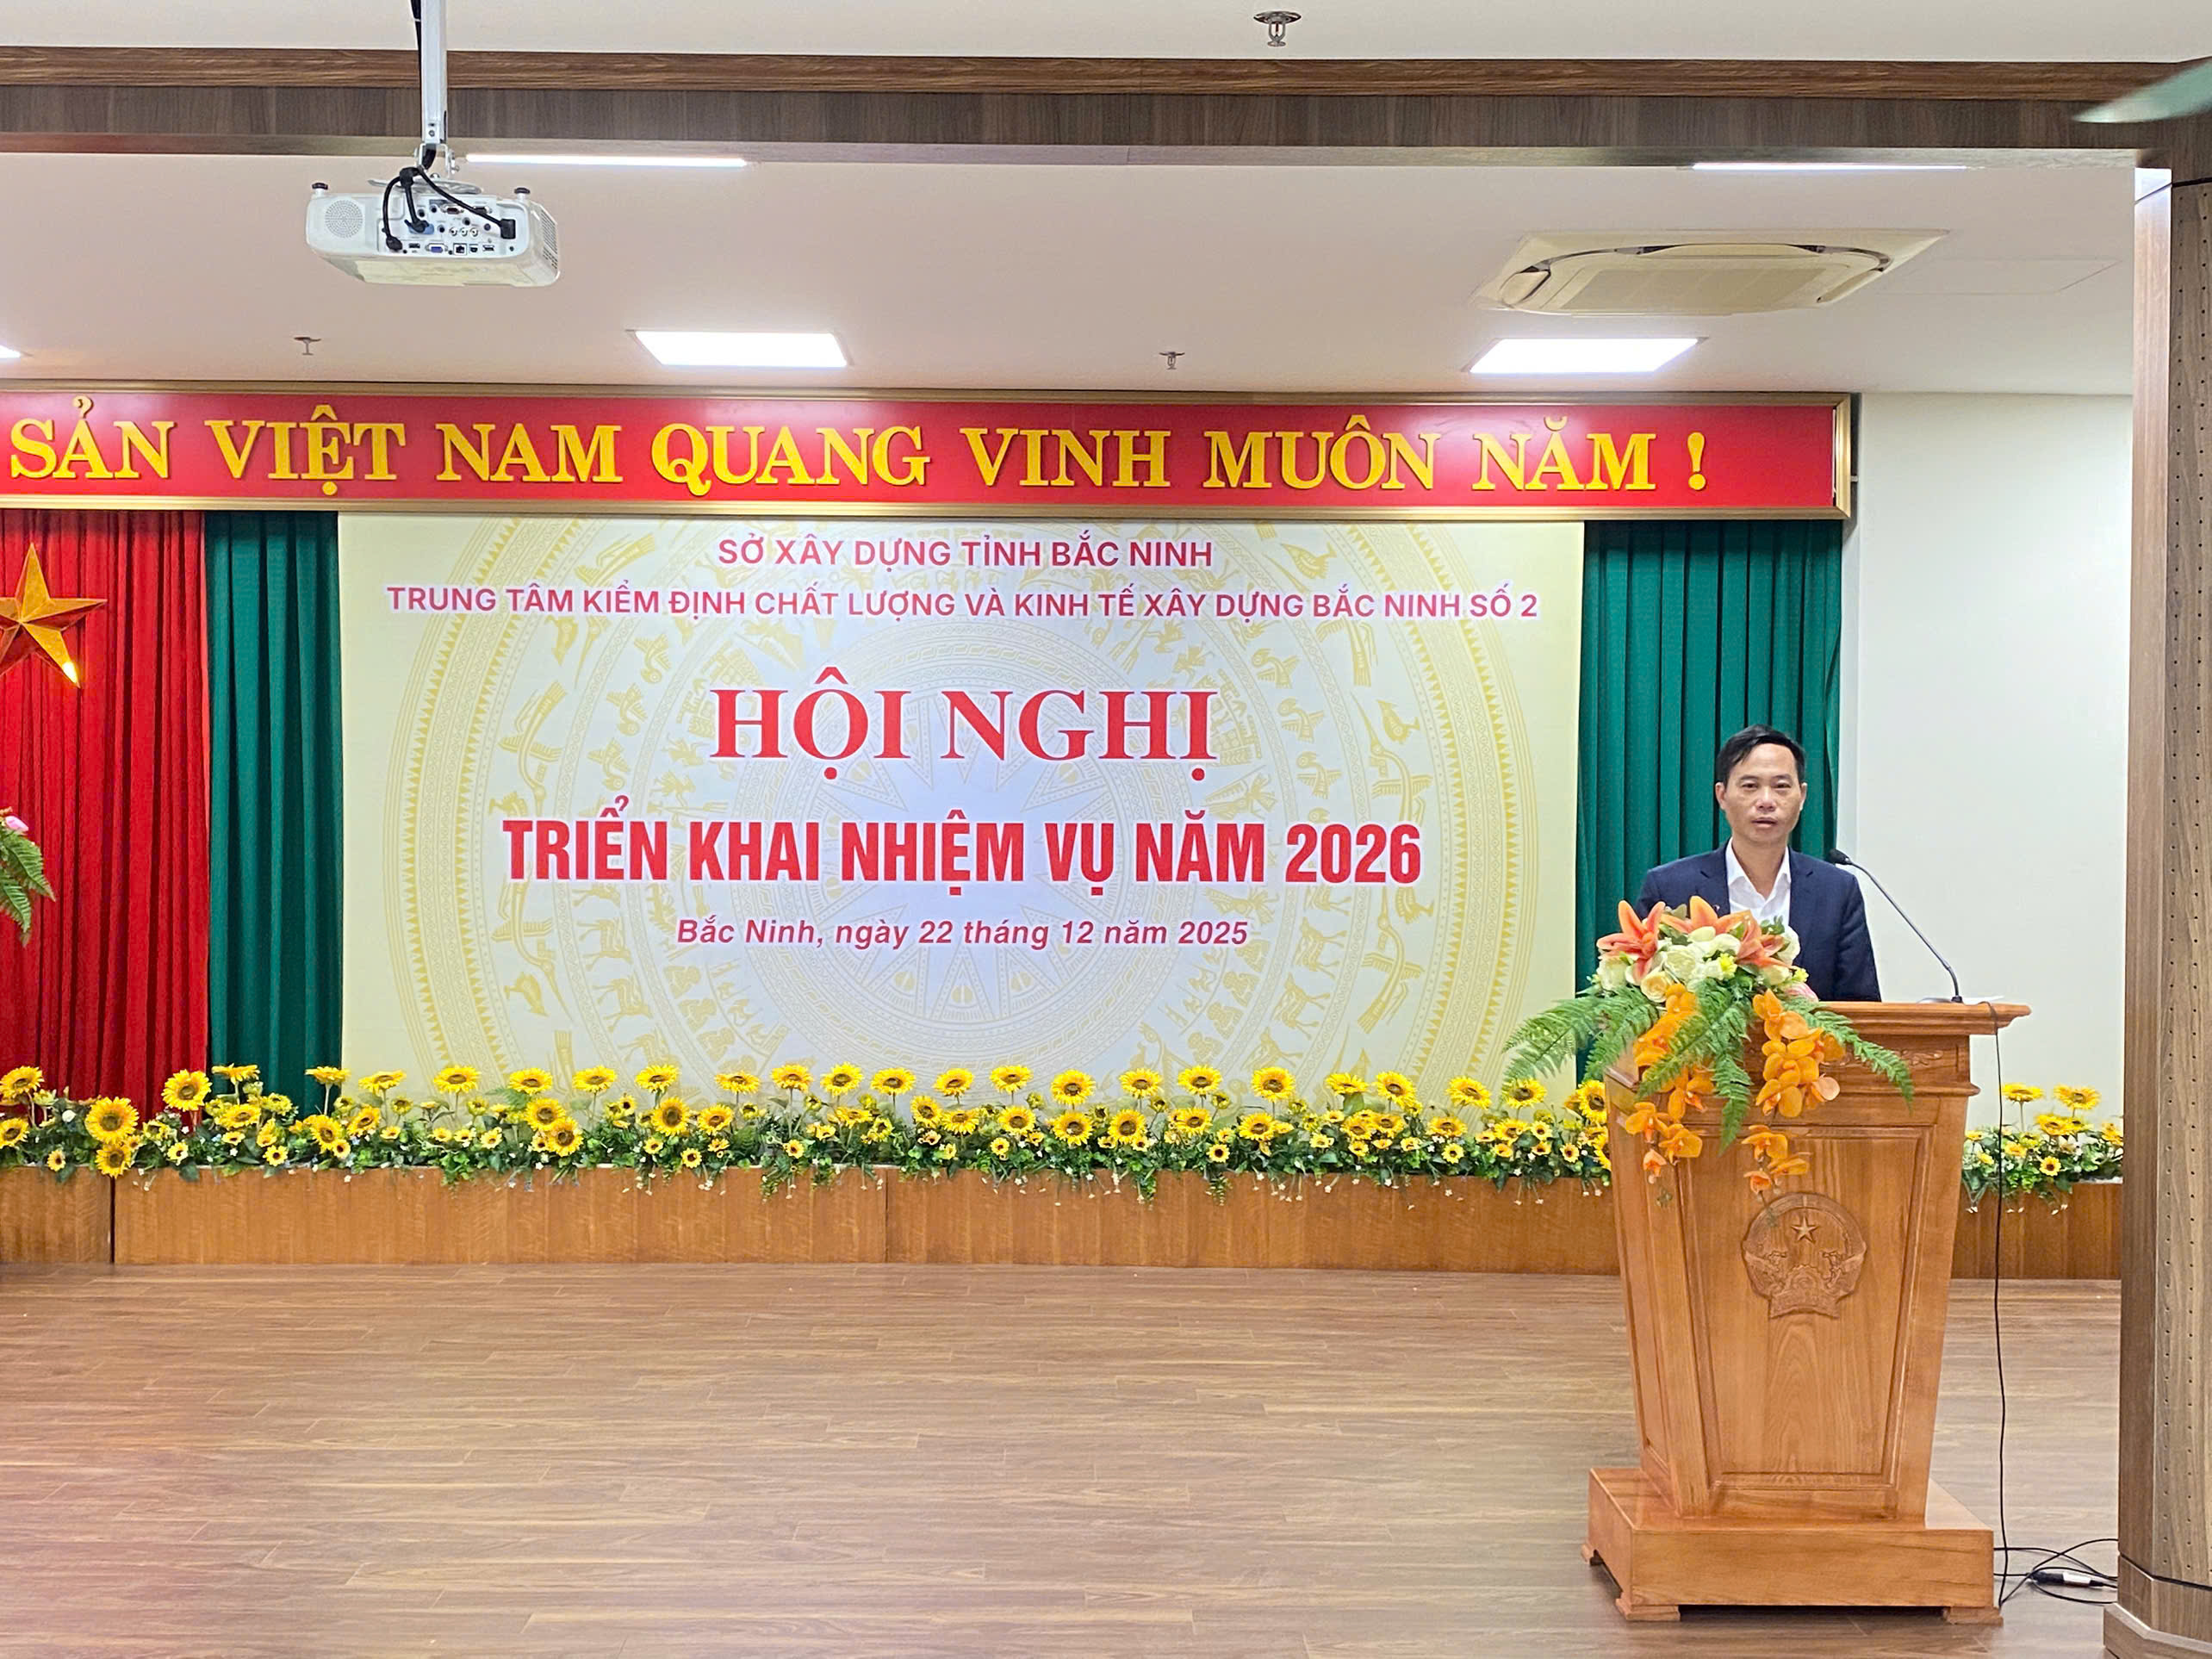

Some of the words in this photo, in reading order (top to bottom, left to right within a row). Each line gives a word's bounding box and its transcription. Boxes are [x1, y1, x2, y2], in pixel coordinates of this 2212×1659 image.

[9, 396, 174, 480] SẢN
[204, 404, 406, 495] VIỆT
[437, 423, 624, 483] NAM
[651, 423, 931, 497] QUANG
[960, 427, 1171, 488] VINH
[1203, 413, 1439, 490] MUÔN
[1471, 415, 1656, 491] NĂM
[1687, 432, 1707, 491] !
[718, 534, 765, 565] SỞ
[776, 534, 843, 565] XÂY
[854, 539, 950, 572] DỰNG
[961, 531, 1041, 567] TỈNH
[1051, 529, 1118, 567] BẮC
[1129, 541, 1212, 567] NINH
[388, 586, 496, 612] TRUNG
[506, 582, 574, 612] TÂM
[583, 578, 660, 614] KIỂM
[668, 591, 745, 621] ĐỊNH
[755, 582, 839, 615] CHẤT
[848, 591, 955, 622] LƯỢNG
[965, 585, 1004, 617] VÀ
[1015, 593, 1088, 617] KINH
[1097, 582, 1134, 617] TẾ
[1144, 586, 1206, 618] XÂY
[1215, 592, 1304, 624] DỰNG
[1313, 581, 1375, 618] BẮC
[1383, 593, 1460, 618] NINH
[1469, 581, 1513, 618] SỐ
[1520, 594, 1538, 618] 2
[711, 666, 910, 780] HỘI
[941, 689, 1217, 782] NGHỊ
[503, 794, 668, 881] TRIỂN
[689, 821, 819, 882] KHAI
[841, 809, 1024, 896] NHIỆM
[1043, 822, 1115, 898] VỤ
[1135, 809, 1265, 883] NĂM
[1285, 823, 1421, 885] 2026
[677, 915, 734, 943] Bắc
[745, 919, 824, 948] Ninh,
[835, 920, 908, 950] ngày
[918, 920, 953, 943] 22
[963, 919, 1049, 950] tháng
[1062, 920, 1094, 944] 12
[1104, 920, 1167, 944] năm
[1177, 920, 1249, 946] 2025
